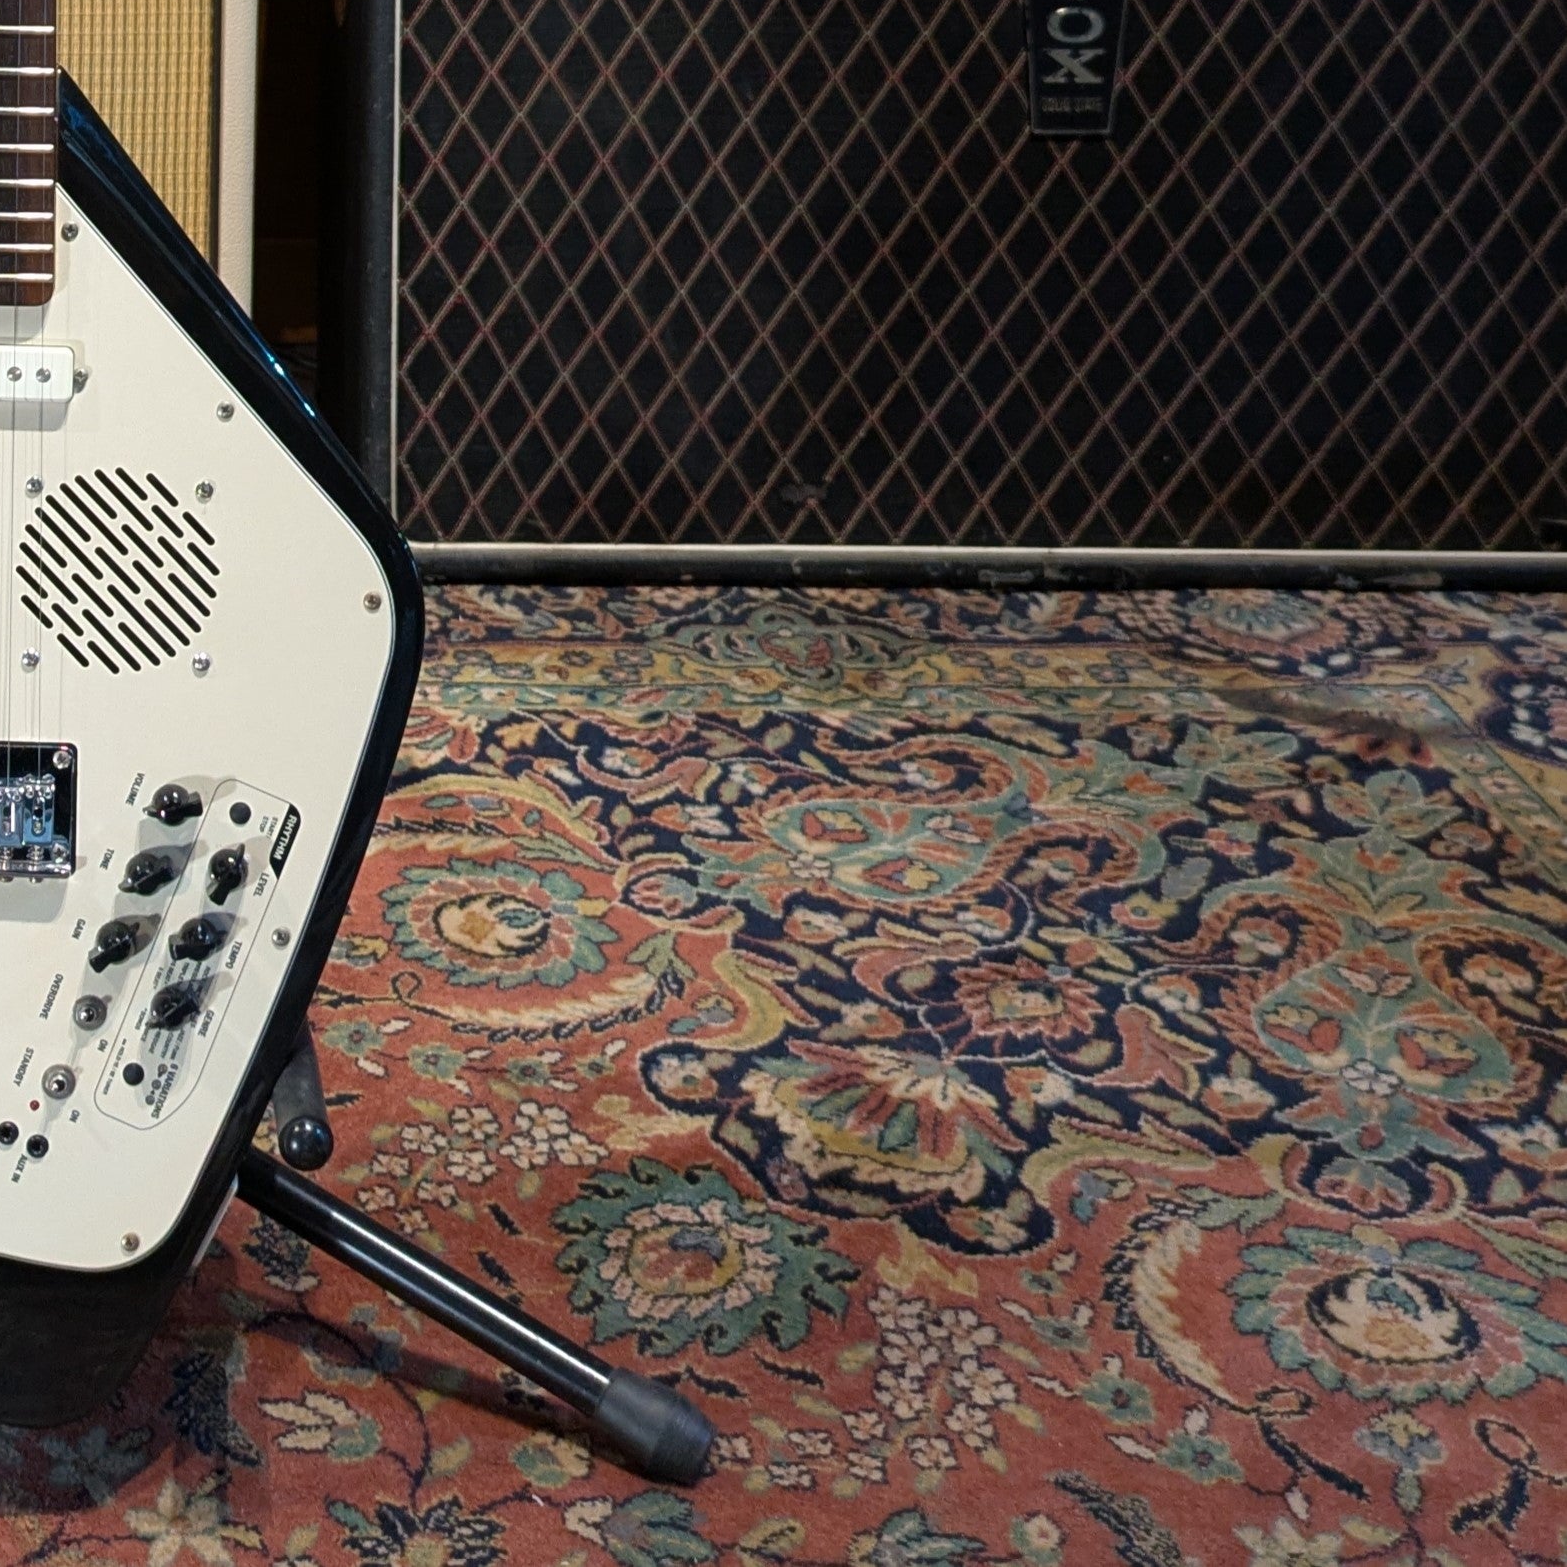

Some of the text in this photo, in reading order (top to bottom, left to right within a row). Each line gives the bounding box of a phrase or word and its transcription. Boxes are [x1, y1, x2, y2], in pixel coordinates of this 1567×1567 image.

[124, 771, 145, 806] VOLUME
[258, 815, 269, 833] STOP
[272, 813, 298, 861] RHYTHM
[99, 847, 114, 870] TONE
[252, 872, 270, 899] LEVEL
[70, 918, 86, 940] GAIN
[224, 940, 242, 969] TEMPO
[38, 973, 64, 1020] OVERDRIVE
[197, 1009, 215, 1038] GENRE
[96, 1038, 108, 1053] ON
[11, 1046, 34, 1087] STANDBY
[150, 1070, 176, 1119] VARIATIONS
[68, 1109, 80, 1123] ON
[10, 1154, 28, 1183] AUX IN
